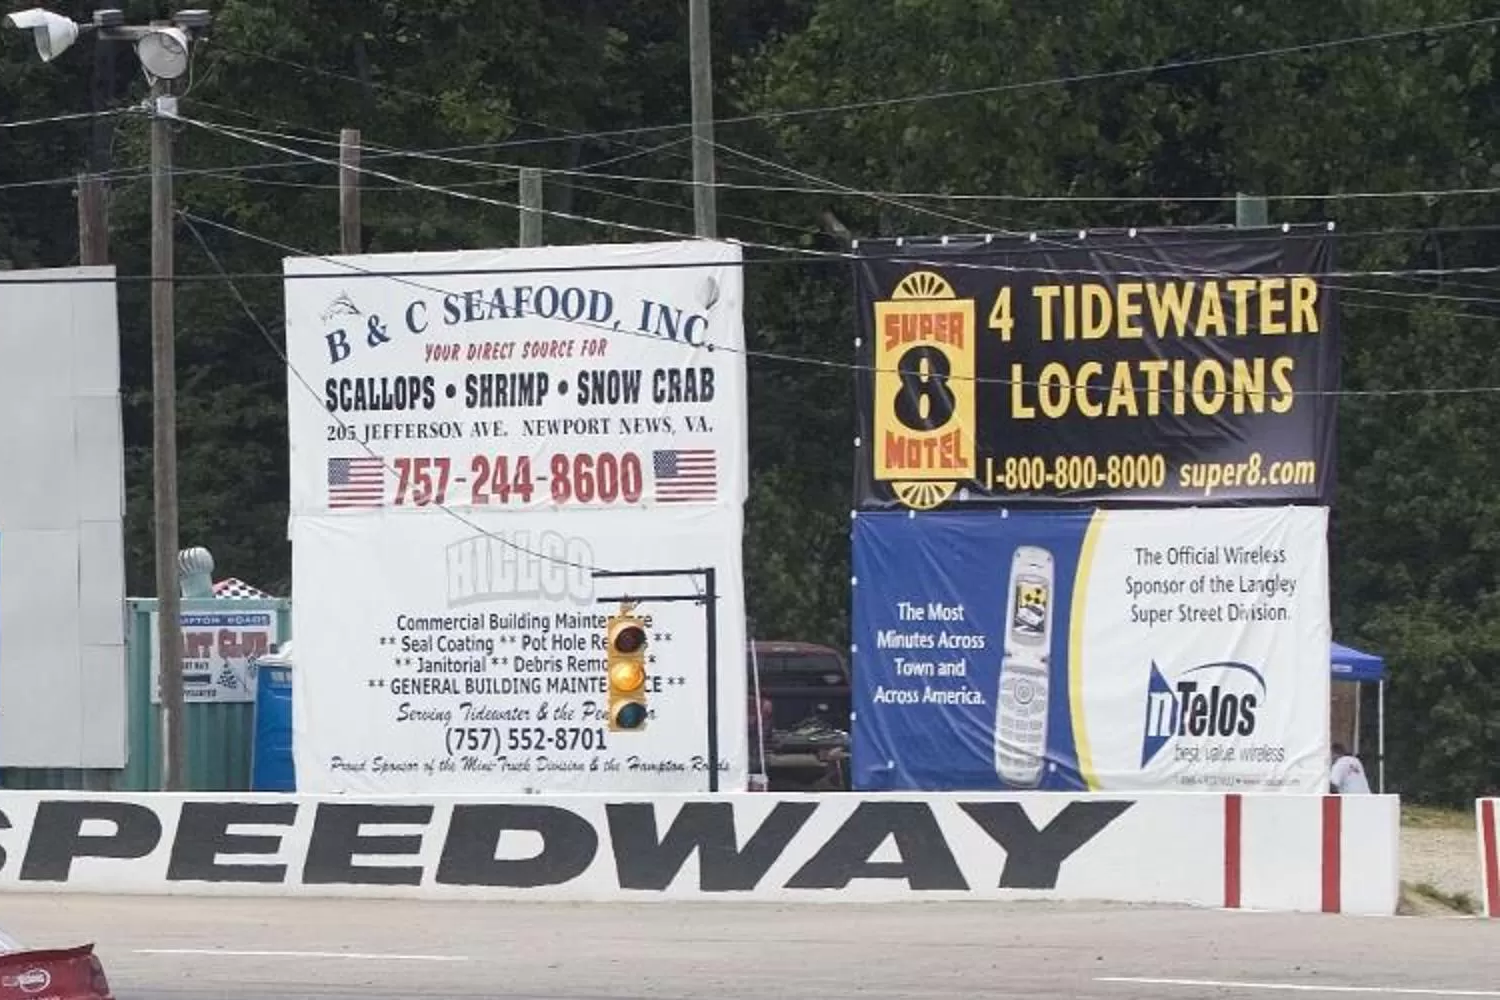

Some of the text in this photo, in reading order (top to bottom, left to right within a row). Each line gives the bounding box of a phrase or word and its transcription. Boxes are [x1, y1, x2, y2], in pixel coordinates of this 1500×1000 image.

[988, 278, 1319, 342] 4 TIDEWATER
[325, 284, 715, 366] B & C SEAFOOD, INC.
[883, 311, 964, 352] SUPER
[424, 338, 609, 363] YOUR DIRECT SOURCE FOR
[325, 366, 716, 412] SCALLOPS SHRIMP SNOW CRAB
[893, 345, 957, 432] 8
[1011, 356, 1295, 420] LOCATIONS
[363, 421, 463, 443] JEFFERSON
[469, 420, 509, 438] AVE.
[521, 417, 612, 437] NEWPORT
[619, 416, 677, 436] NEWS,
[683, 415, 714, 434] VA.
[884, 429, 968, 470] MOTEL
[393, 451, 643, 508] 757-244-8600
[986, 452, 1316, 496] 1-800-800-8000 super8.com
[1135, 544, 1286, 566] The Official Wireless
[1125, 573, 1297, 598] Sponsor of the Langley
[396, 612, 653, 633] Commercial Building Maintee
[897, 602, 964, 622] The Most
[1131, 604, 1173, 625] Super
[1177, 604, 1223, 623] Street
[401, 635, 433, 652] Seal
[437, 634, 495, 656] Coating
[522, 633, 548, 651] Pot
[551, 633, 587, 651] Hole
[876, 630, 985, 651] Minutes Across
[416, 656, 487, 673] Janitorial
[514, 655, 563, 673] Debris
[894, 658, 966, 677] Town and
[390, 676, 663, 695] GENERAL BUILDING MAINTECE
[873, 686, 986, 706] Across America.
[396, 701, 452, 726] Serving
[459, 701, 530, 722] Tidewater
[535, 701, 549, 722] &
[553, 702, 575, 722] the
[445, 727, 607, 756] (757) 552-8701
[372, 755, 419, 775] Sponsor
[439, 756, 456, 773] the
[603, 756, 621, 772] the
[627, 755, 685, 776] Hampton
[692, 755, 731, 772] Rods
